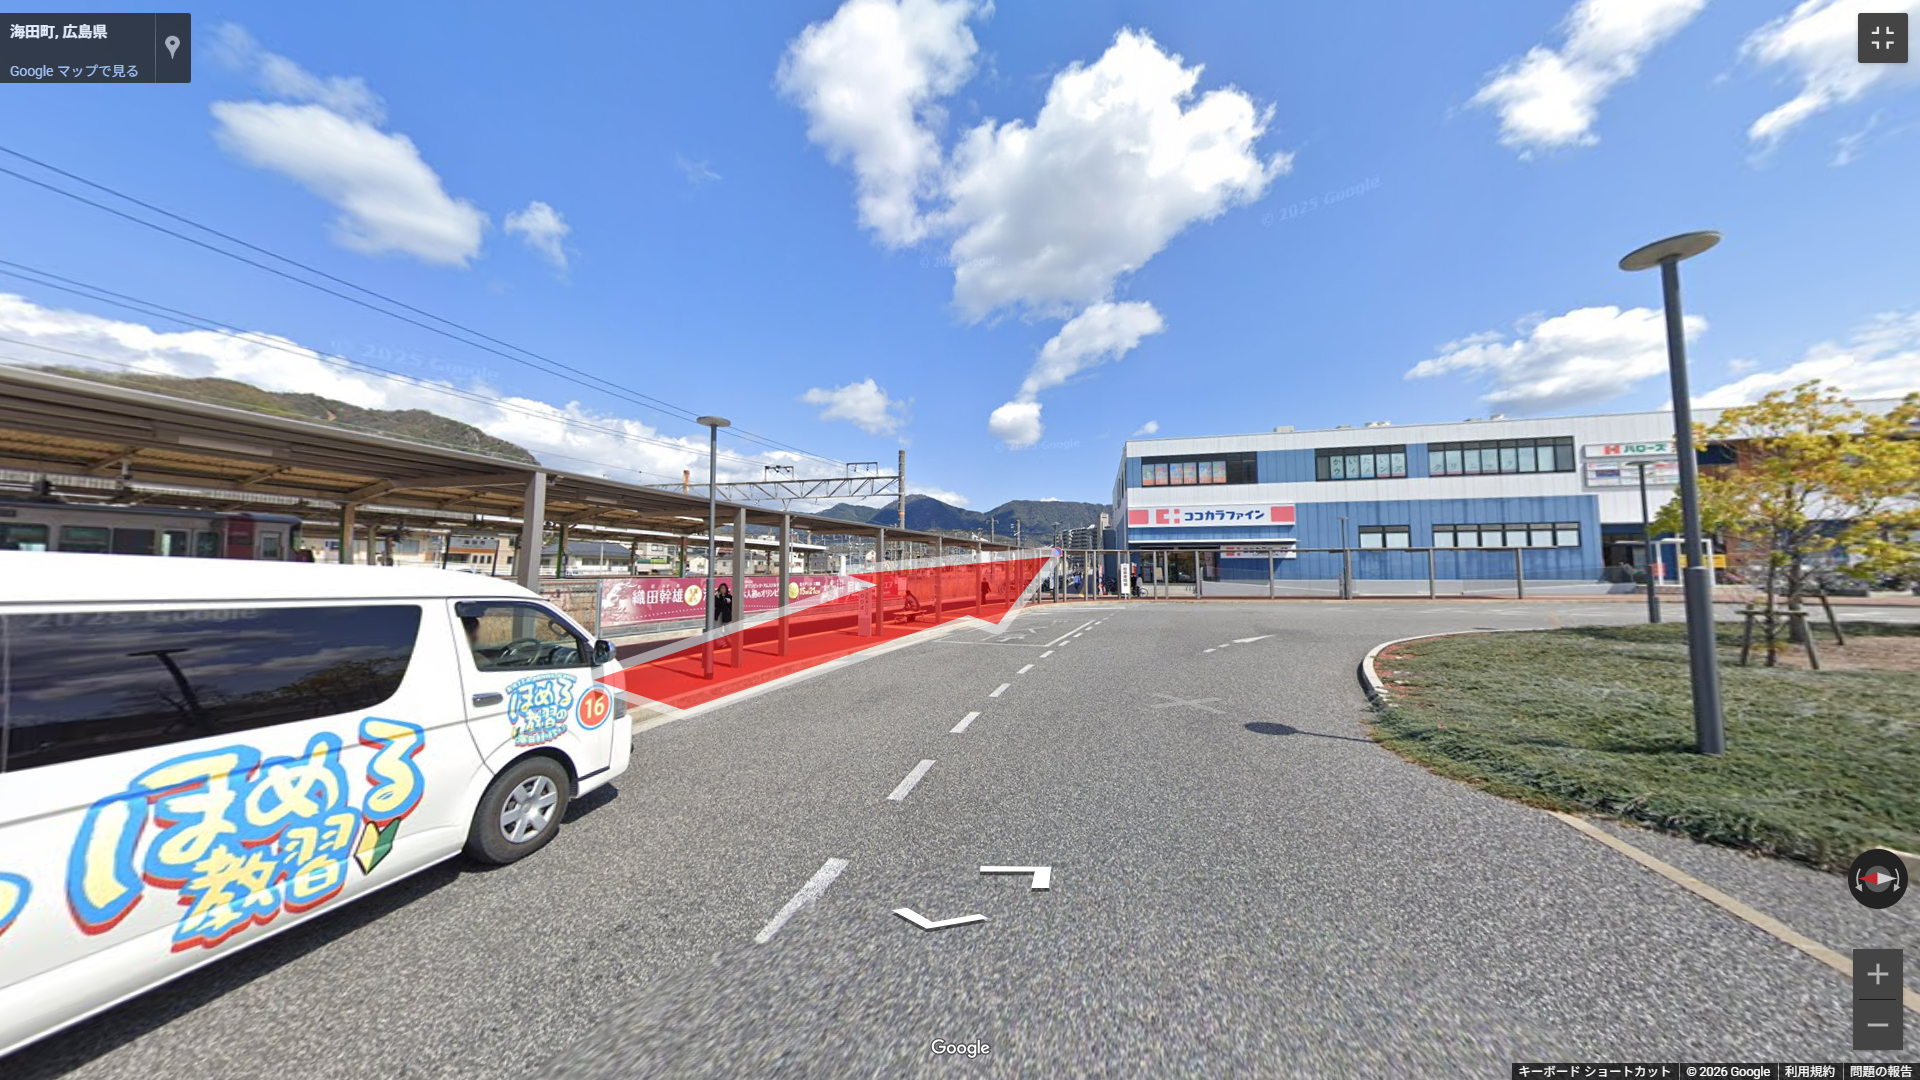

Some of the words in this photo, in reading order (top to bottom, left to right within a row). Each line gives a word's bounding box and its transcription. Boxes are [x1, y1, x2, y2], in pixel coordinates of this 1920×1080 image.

[1624, 443, 1666, 453] ハローズ
[1184, 510, 1265, 521] ココカラファイン
[631, 588, 684, 605] 織田幹雄
[507, 678, 574, 725] ほめる
[585, 695, 605, 719] 16
[70, 717, 424, 932] ほめる
[175, 809, 359, 945] 教習
